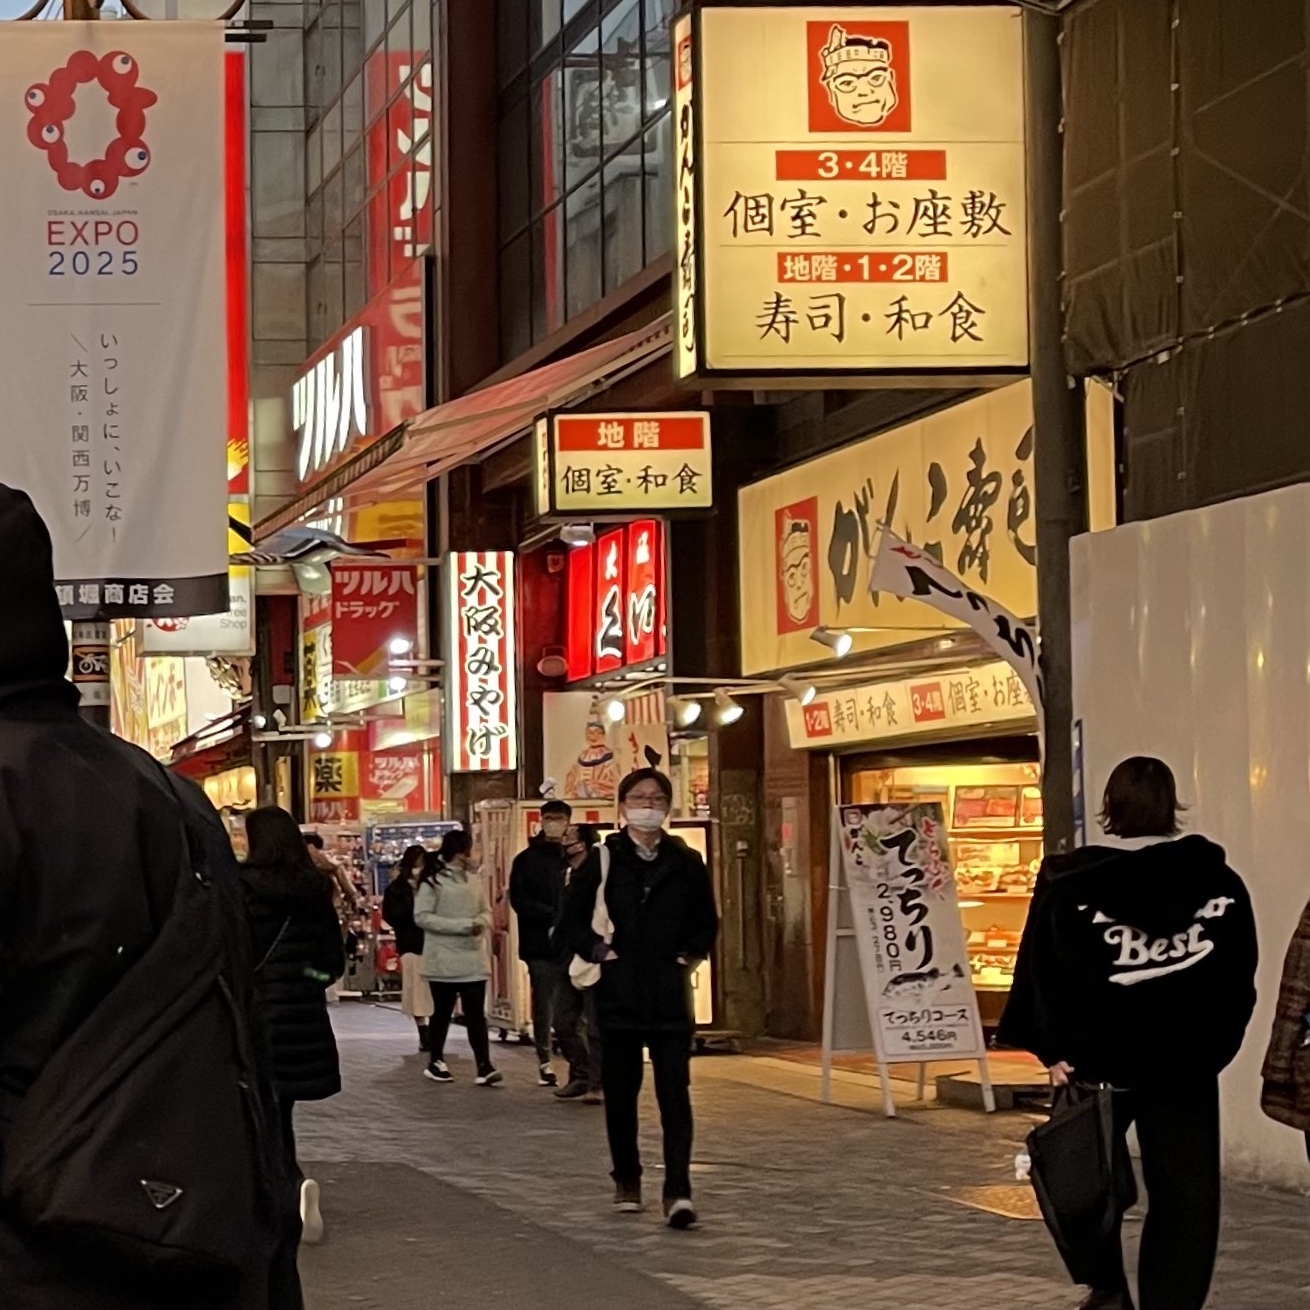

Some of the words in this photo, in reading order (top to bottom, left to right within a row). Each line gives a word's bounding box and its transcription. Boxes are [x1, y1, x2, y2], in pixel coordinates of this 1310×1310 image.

[723, 189, 1012, 239] 個室・お座敷
[47, 220, 139, 246] EXPO
[48, 250, 138, 276] 2025
[755, 291, 987, 344] 寿司・和食
[70, 358, 91, 518] 大阪・関西万博
[597, 421, 660, 449] 地階
[560, 462, 703, 497] 個室・和食
[335, 571, 415, 596] ツルハ
[220, 619, 247, 630] Shop
[335, 601, 400, 619] ドラッグ
[463, 565, 508, 757] 大阪みやげ
[314, 757, 343, 793] 薬
[879, 829, 934, 971] てっちり
[1104, 923, 1215, 966] Best
[883, 1008, 969, 1025] てっちりコース
